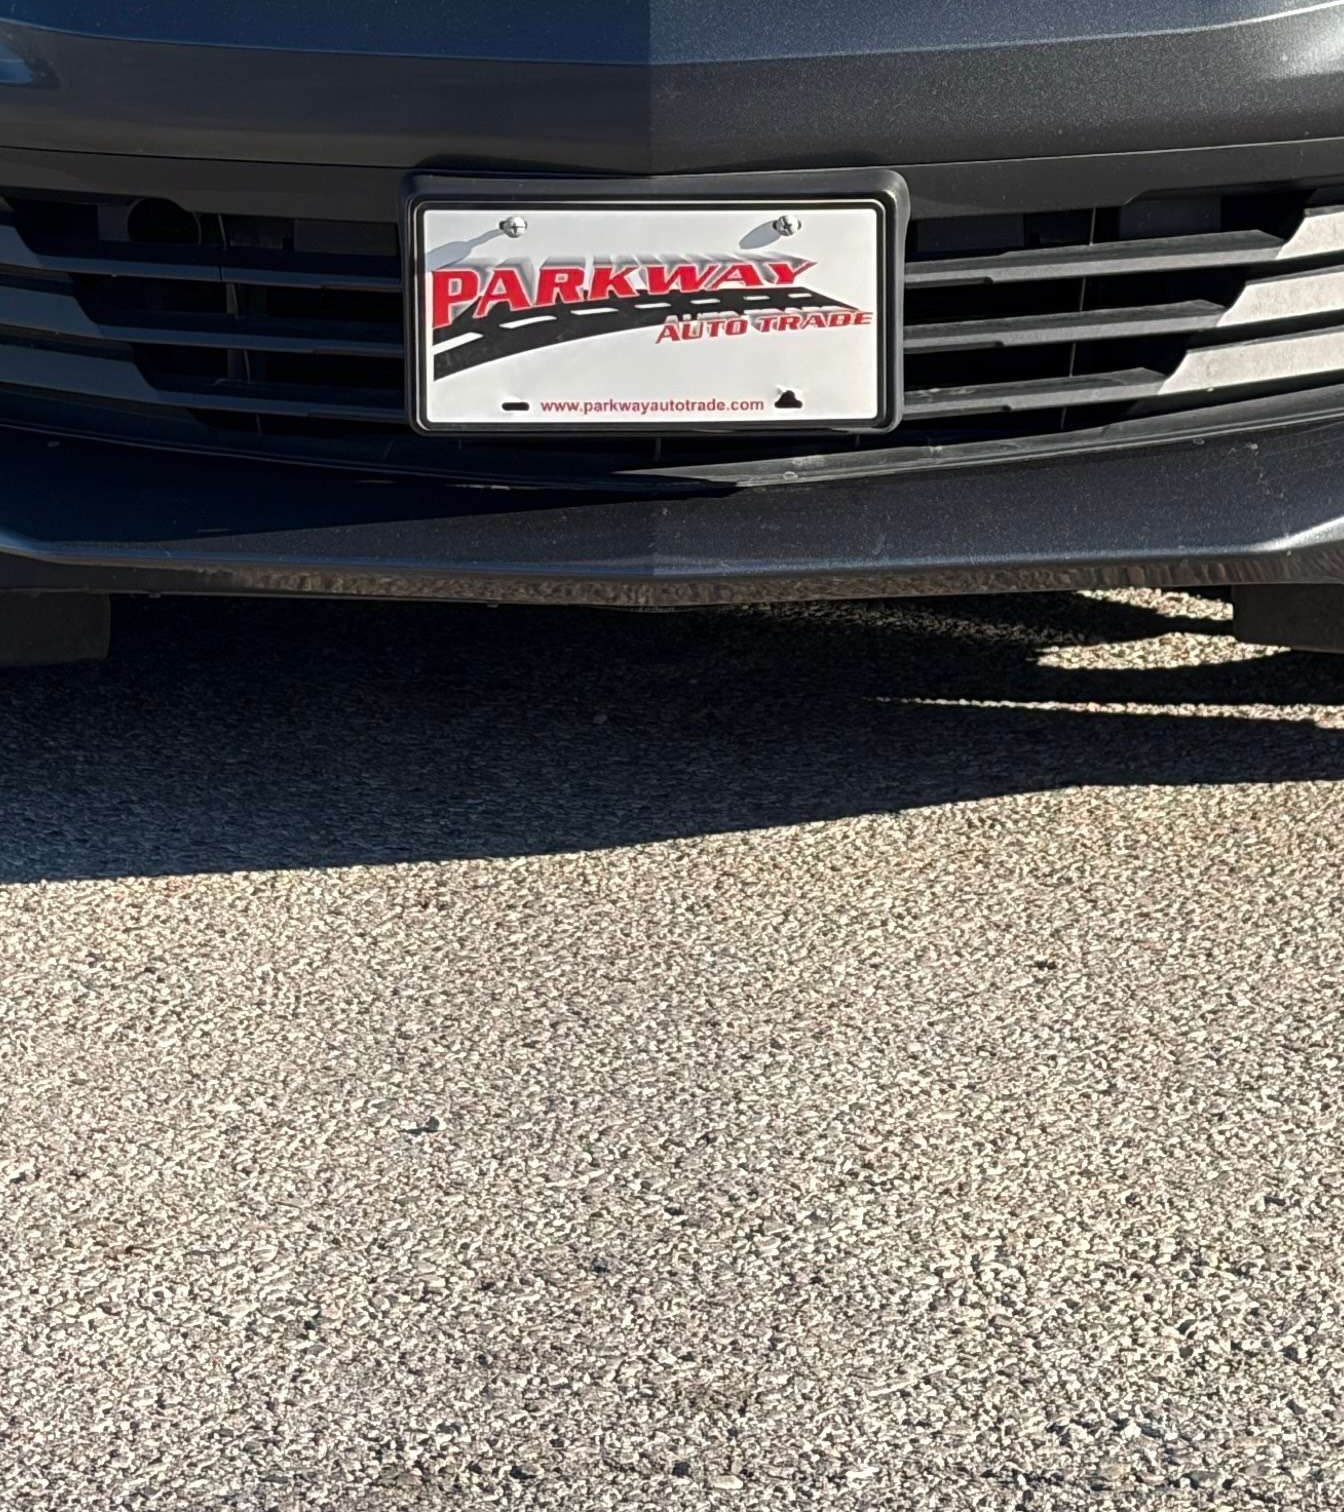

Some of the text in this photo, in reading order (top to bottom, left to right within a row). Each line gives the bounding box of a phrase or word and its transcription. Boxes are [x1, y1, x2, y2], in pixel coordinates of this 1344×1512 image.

[431, 261, 818, 329] PARKWAY
[655, 311, 874, 344] AUTO TRADE
[540, 398, 765, 415] www.parkwayautotrade.com
